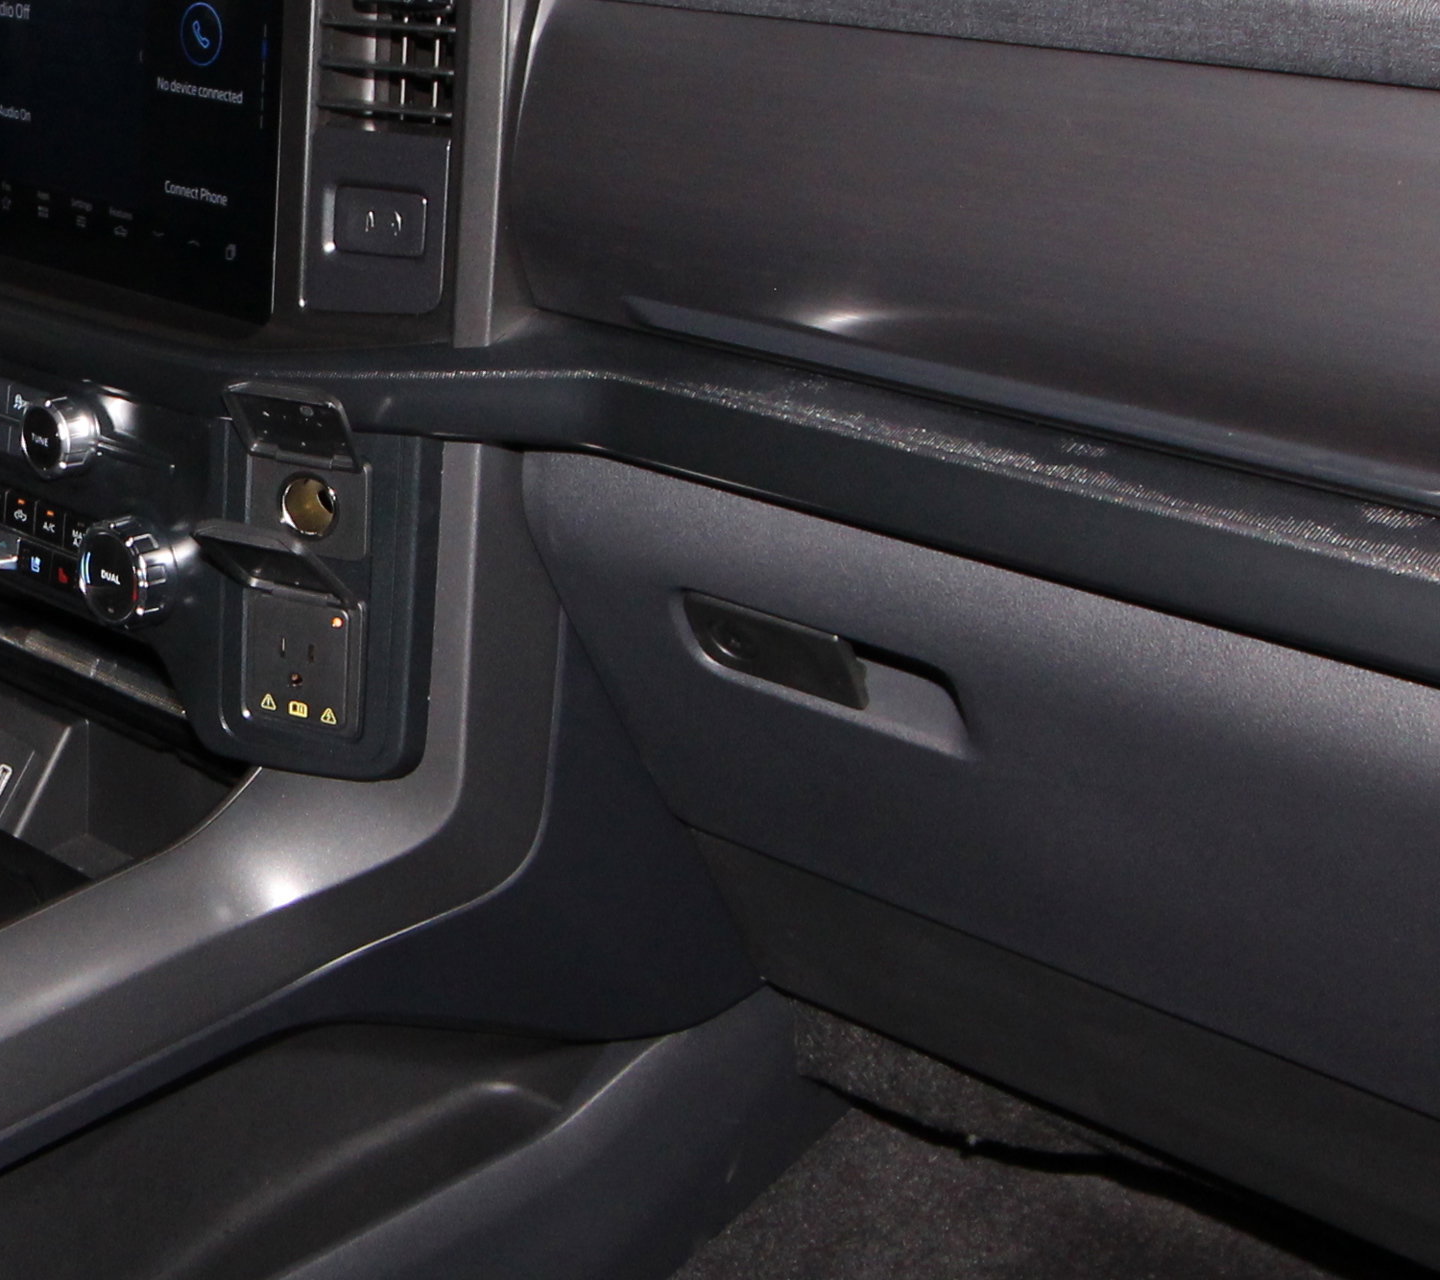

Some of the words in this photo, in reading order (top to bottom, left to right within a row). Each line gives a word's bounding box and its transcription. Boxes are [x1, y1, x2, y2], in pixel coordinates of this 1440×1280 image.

[16, 3, 31, 20] Off
[157, 76, 169, 92] No
[170, 80, 197, 96] device
[198, 86, 244, 104] connected
[0, 104, 19, 120] Audio
[20, 108, 31, 122] On
[165, 180, 198, 200] Connect
[200, 187, 228, 206] Phone
[31, 431, 49, 448] TUNE
[43, 521, 55, 533] A/C
[101, 568, 120, 585] DUAL
